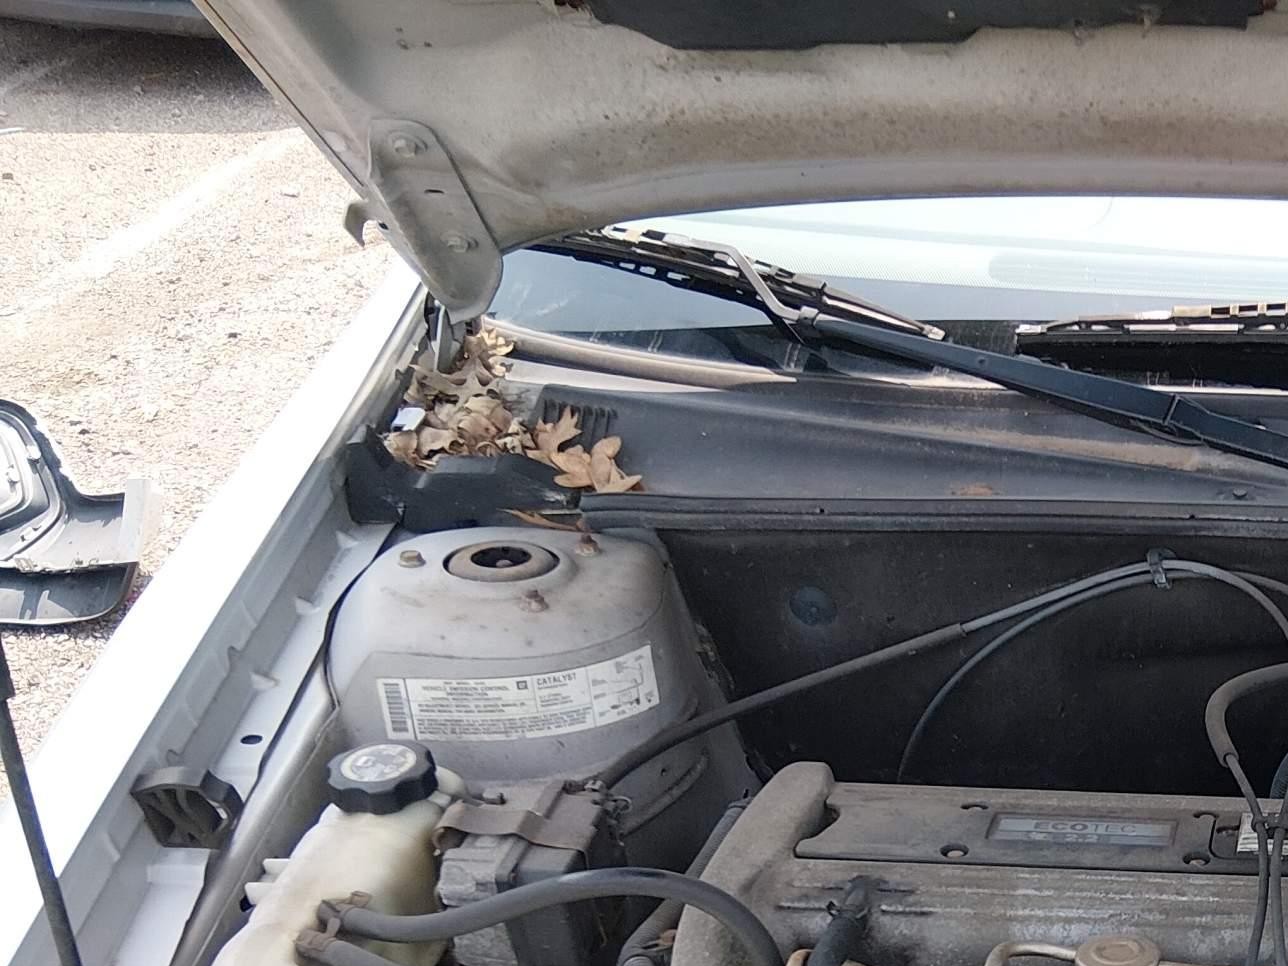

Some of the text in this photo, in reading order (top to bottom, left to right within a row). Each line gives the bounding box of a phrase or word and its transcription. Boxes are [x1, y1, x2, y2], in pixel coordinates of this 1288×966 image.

[536, 672, 577, 686] CATALYST
[1033, 820, 1137, 834] ECOTEC
[1063, 833, 1099, 843] 2.2
